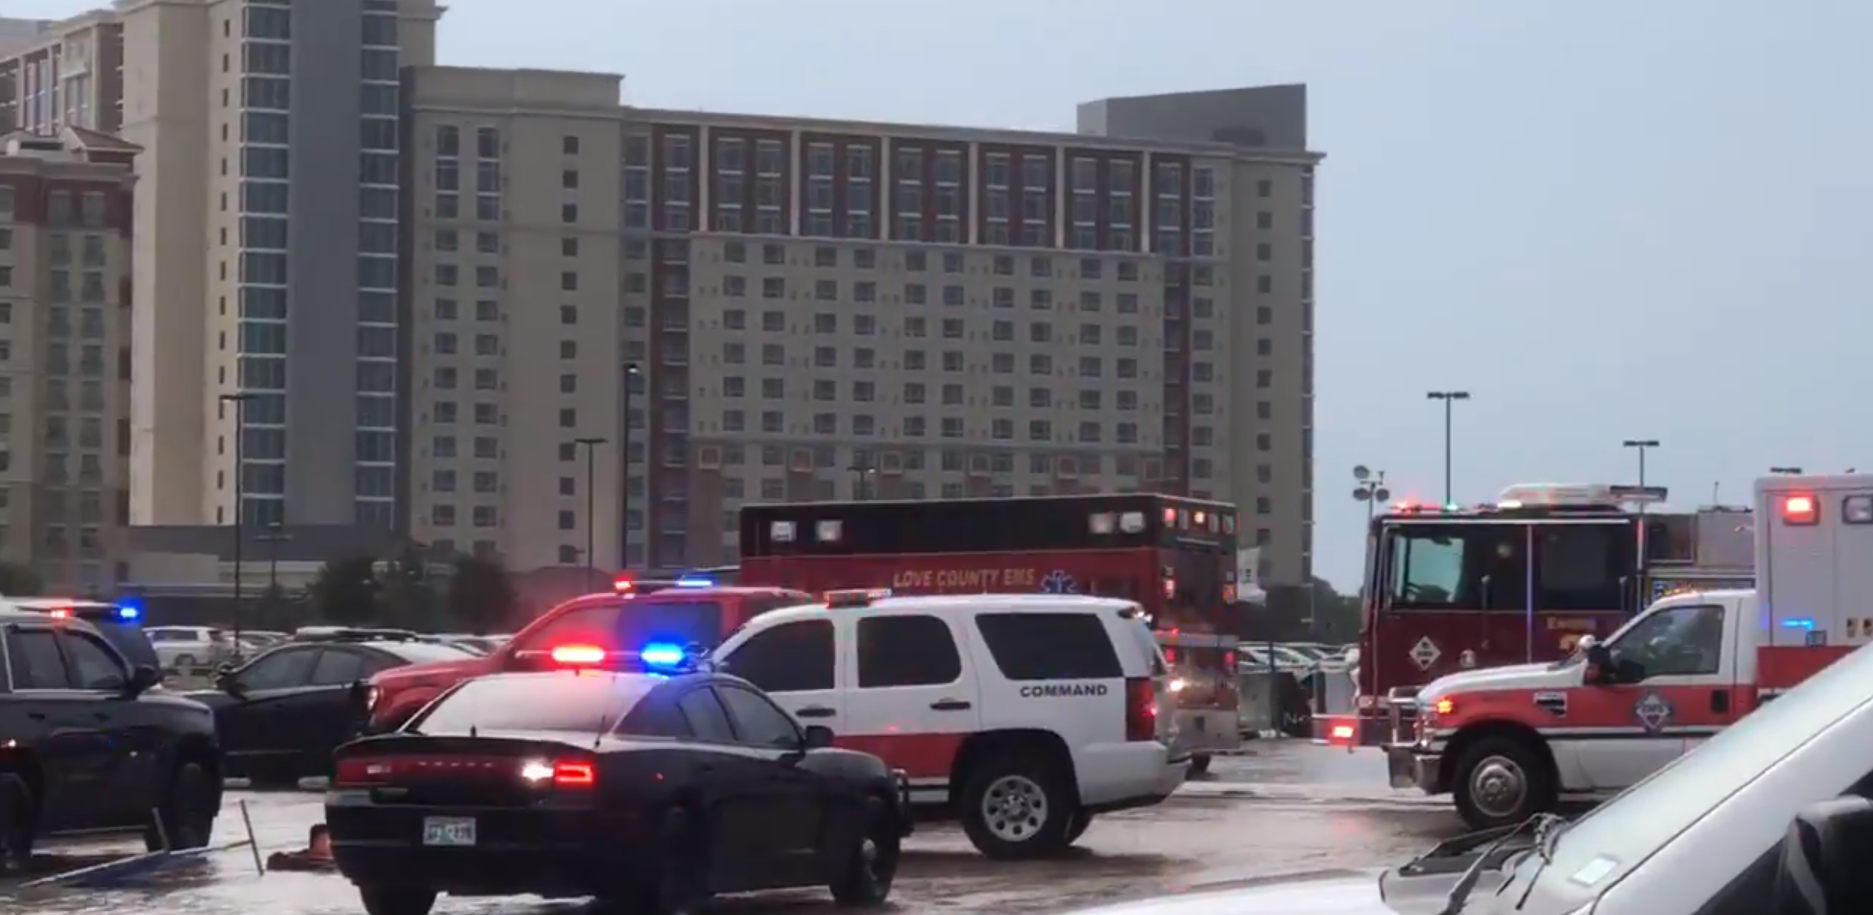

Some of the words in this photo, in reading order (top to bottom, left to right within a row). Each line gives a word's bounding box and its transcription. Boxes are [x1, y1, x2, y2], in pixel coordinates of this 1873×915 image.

[893, 570, 932, 588] LOVE
[936, 569, 999, 587] COUNTY
[1003, 568, 1035, 586] EMS
[1019, 684, 1108, 698] COMMAND
